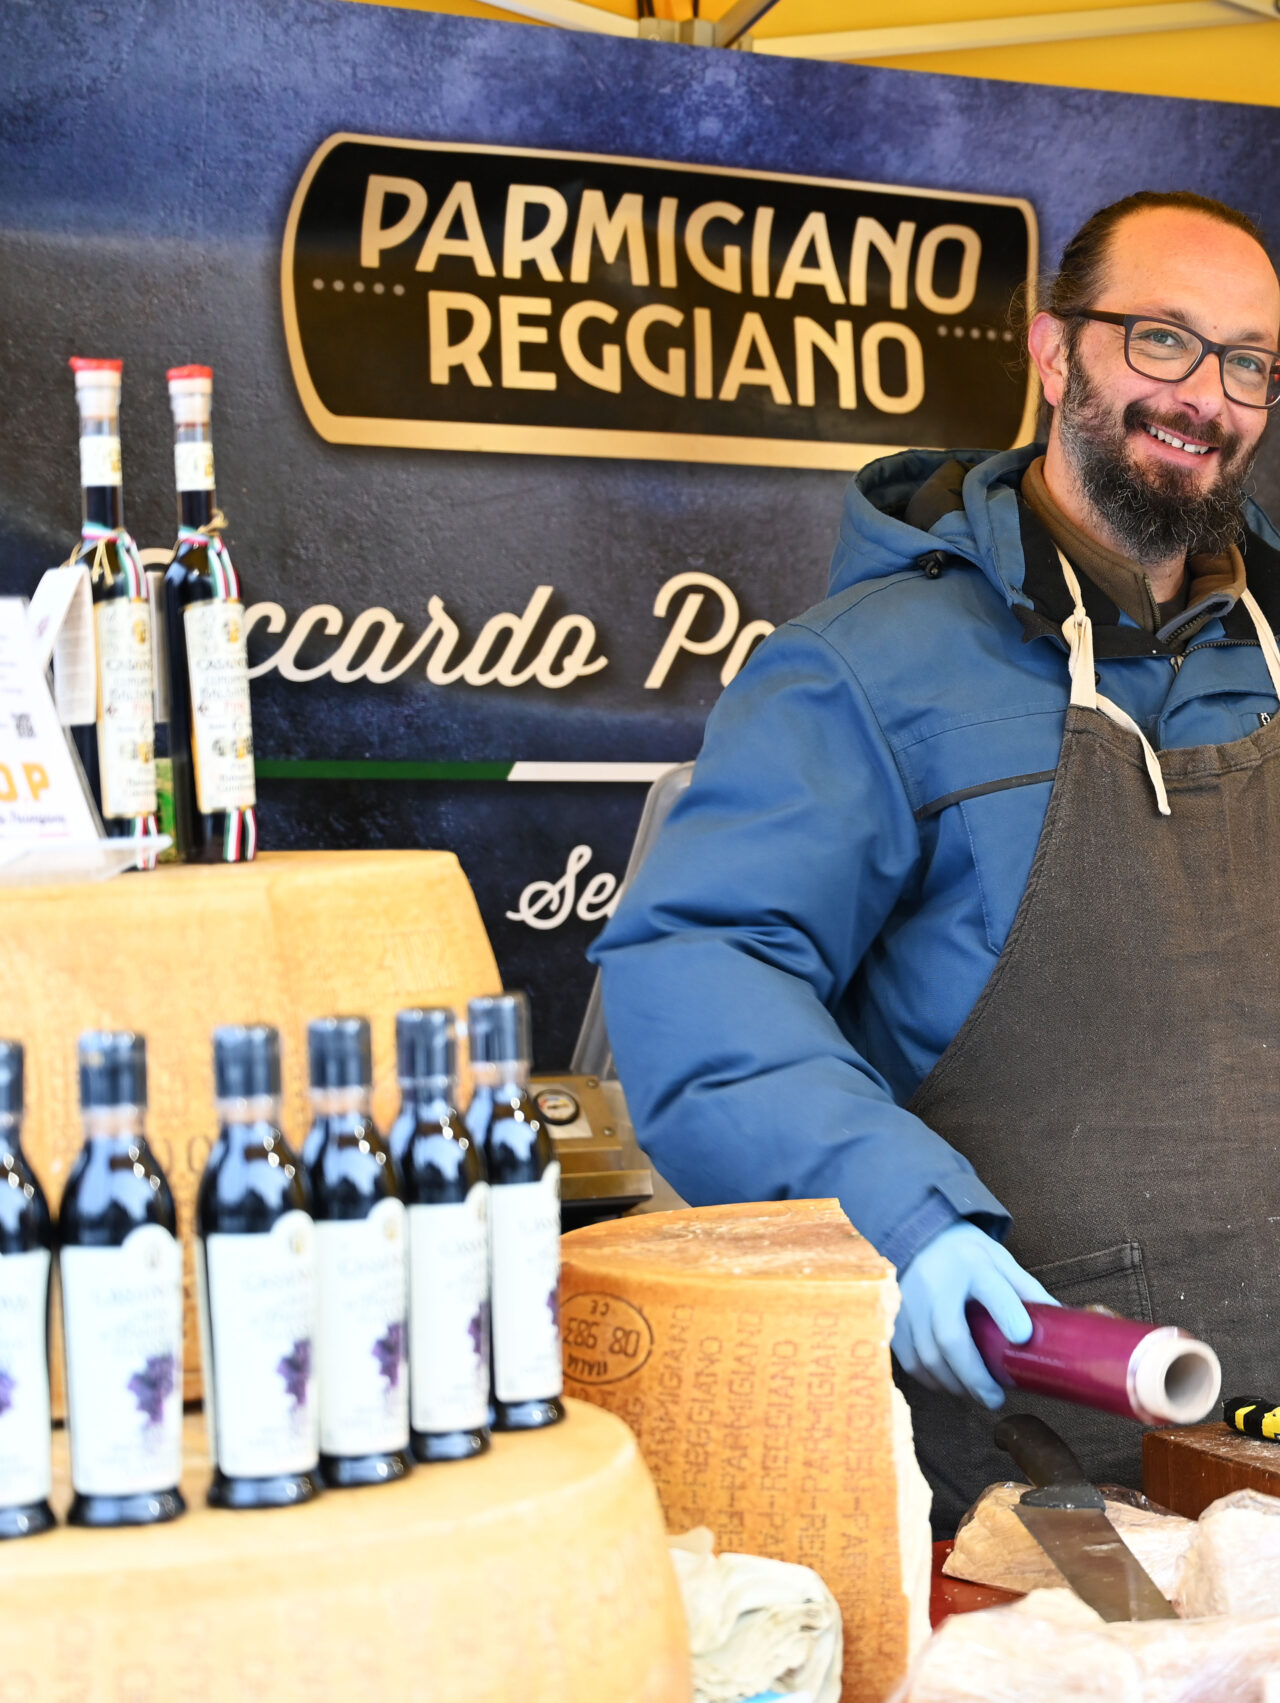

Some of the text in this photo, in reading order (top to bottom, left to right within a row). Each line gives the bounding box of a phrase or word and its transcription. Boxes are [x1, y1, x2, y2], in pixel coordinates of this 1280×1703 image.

[360, 173, 982, 315] PARMIGIANO
[428, 290, 925, 414] REGGIANO
[140, 548, 608, 688] ccardo
[505, 844, 624, 930] Se
